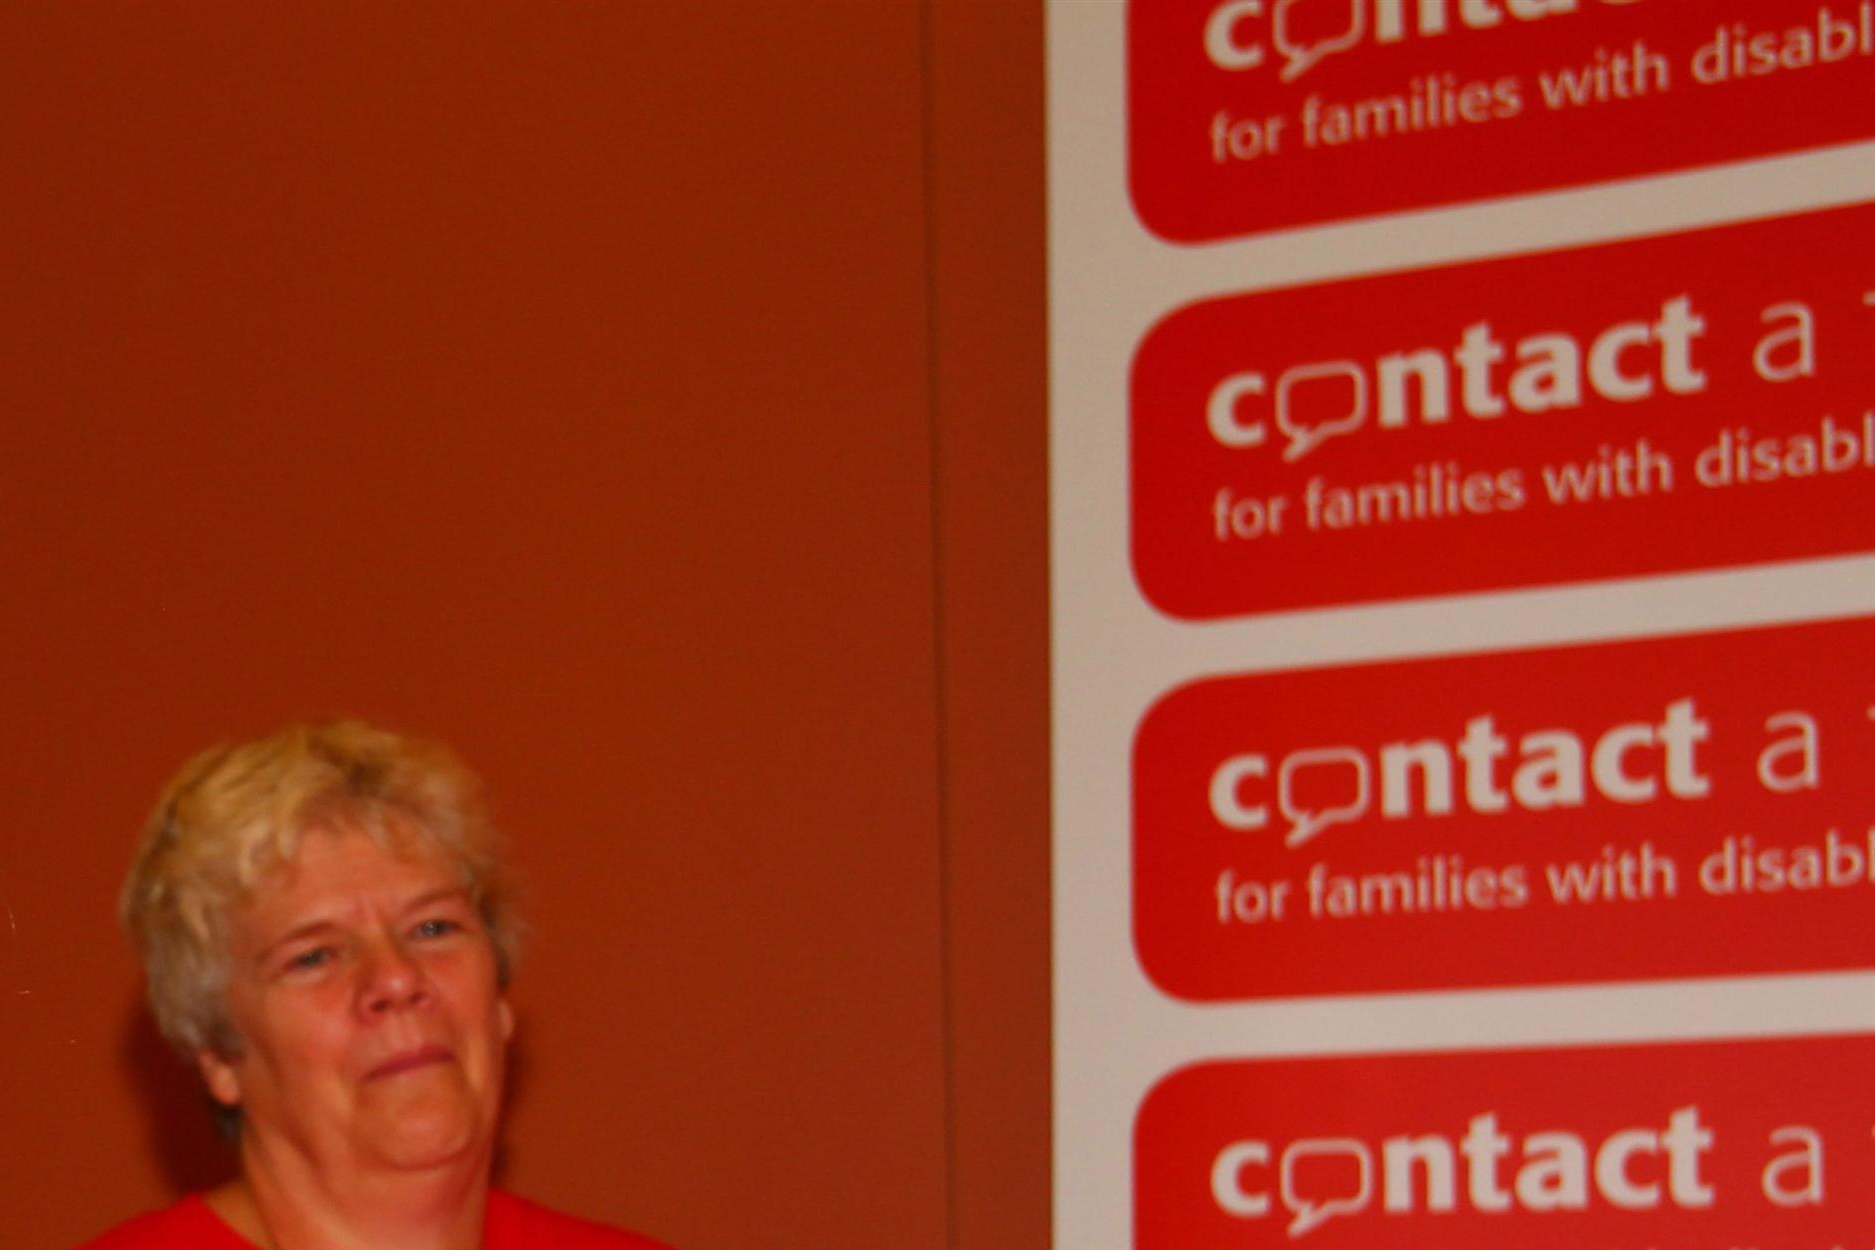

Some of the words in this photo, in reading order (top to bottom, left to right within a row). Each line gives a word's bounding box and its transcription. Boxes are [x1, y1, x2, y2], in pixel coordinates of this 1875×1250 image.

[1210, 110, 1286, 162] for
[1303, 72, 1523, 147] families
[1539, 40, 1670, 109] with
[1206, 294, 1706, 463] contact
[1753, 302, 1816, 382] a
[1213, 487, 1290, 542] for
[1304, 461, 1524, 532] families
[1543, 441, 1673, 506] with
[1209, 696, 1709, 848] contact
[1758, 711, 1819, 792] a
[1215, 867, 1291, 924] for
[1308, 854, 1528, 918] families
[1546, 842, 1676, 905] with
[1210, 1105, 1713, 1240] contact
[1763, 1126, 1824, 1206] a
